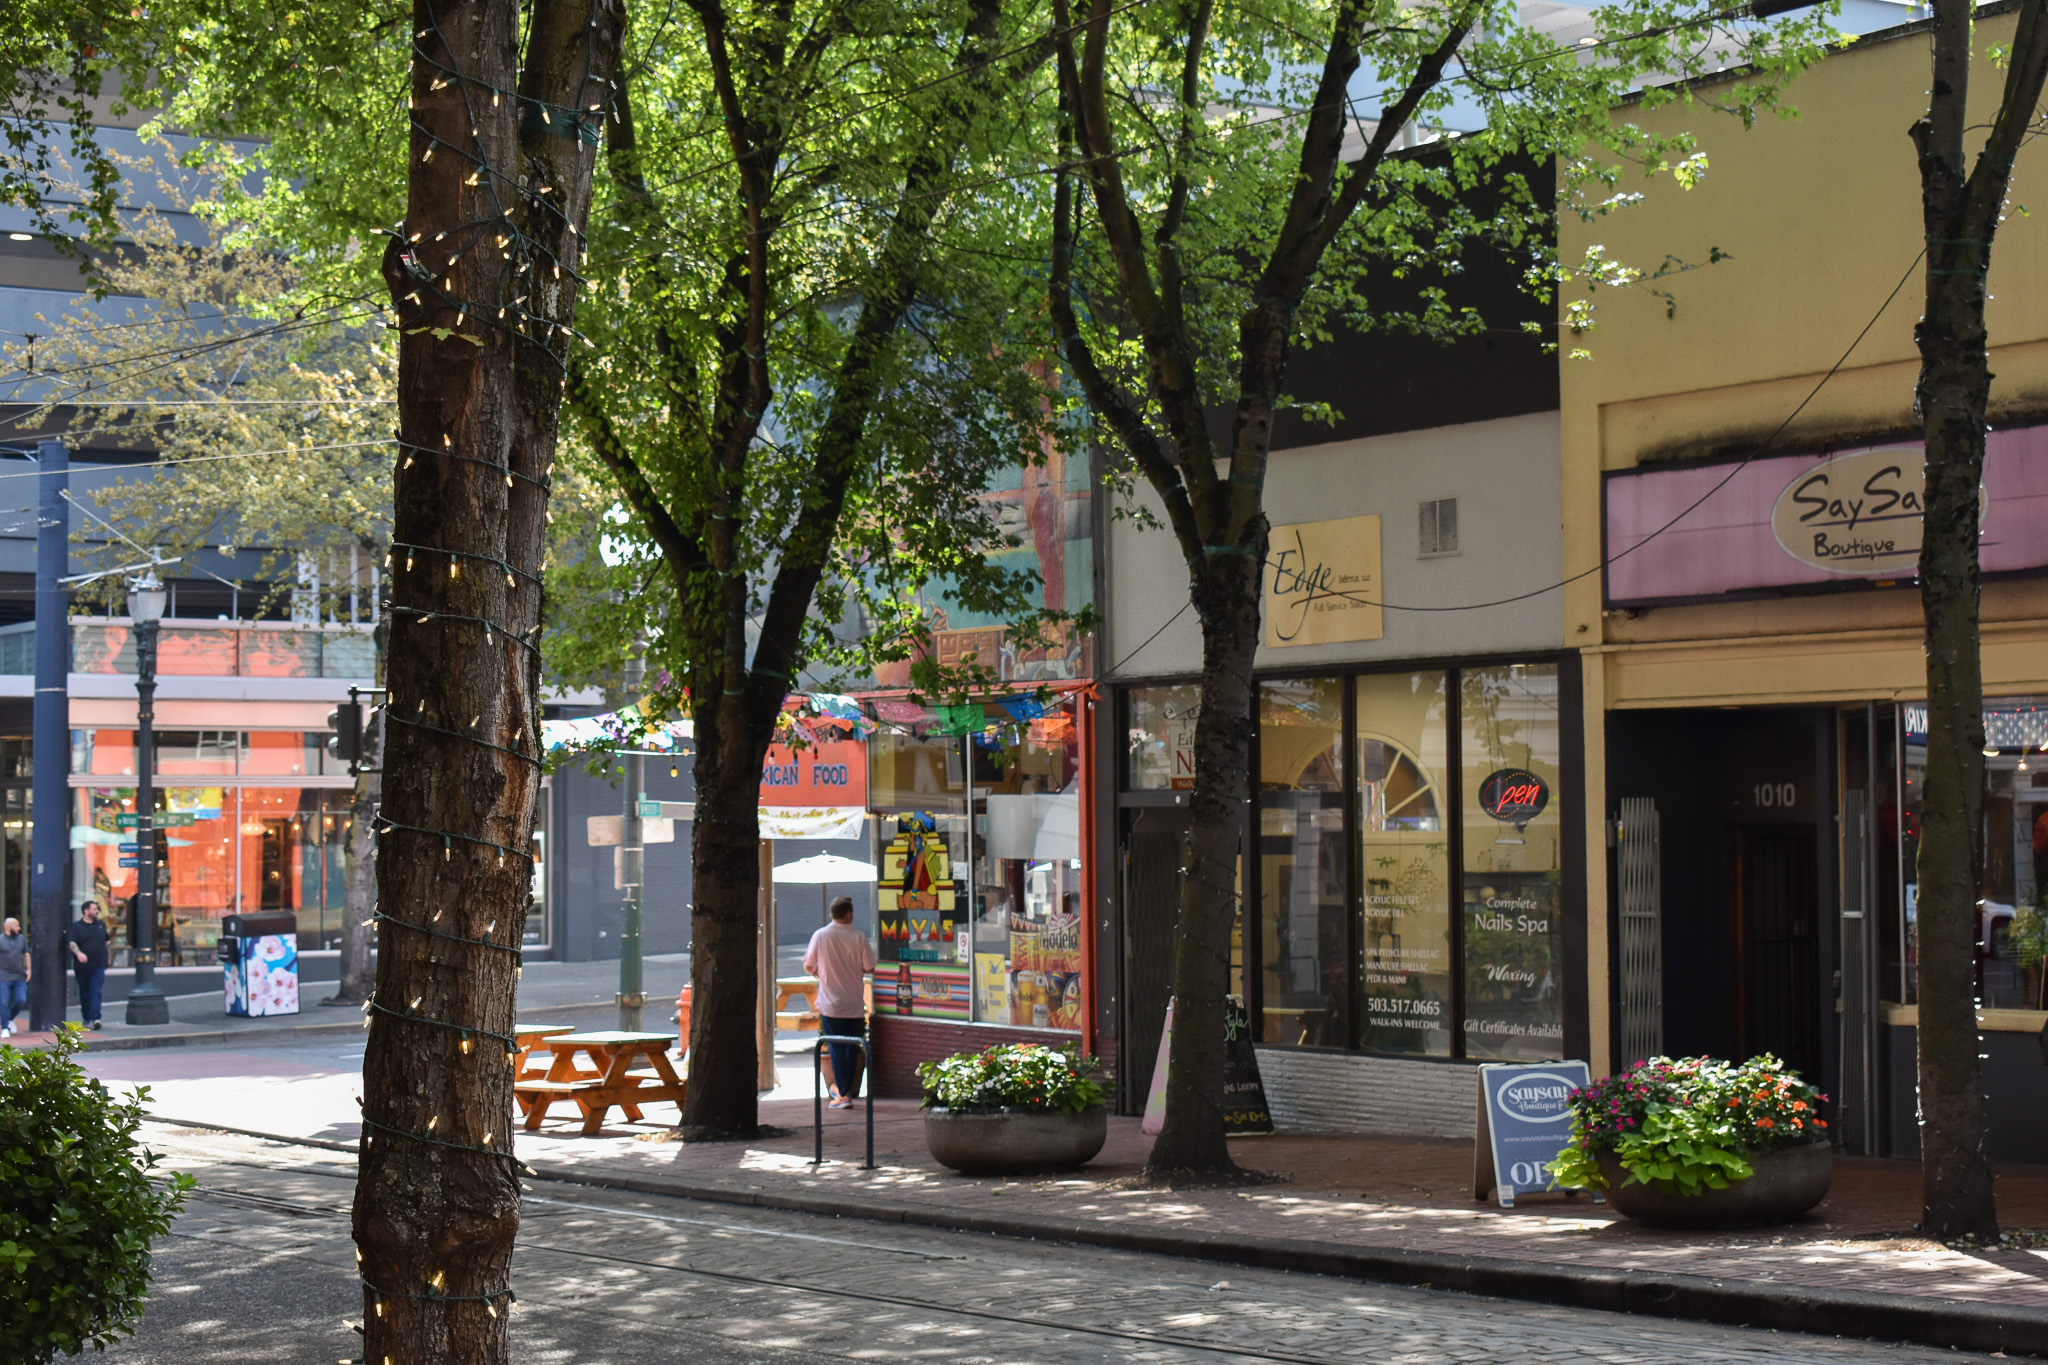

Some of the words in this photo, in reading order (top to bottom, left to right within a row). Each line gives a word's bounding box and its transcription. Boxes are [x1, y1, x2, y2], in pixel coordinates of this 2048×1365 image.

[1793, 466, 1922, 531] SaySa
[1813, 532, 1894, 561] Boutique
[1274, 529, 1335, 640] Edge
[1314, 603, 1325, 612] Full
[1326, 601, 1347, 612] Service
[1177, 729, 1196, 746] Ed
[1176, 750, 1196, 774] N
[759, 764, 799, 786] XICAN
[812, 764, 848, 787] FOOD
[1483, 778, 1540, 813] Open
[1753, 783, 1795, 807] 1010
[1366, 895, 1391, 904] ACRYLIC
[1486, 897, 1537, 911] Complete
[1366, 908, 1391, 917] ACRYLIC
[1392, 908, 1404, 918] FILL
[881, 919, 954, 941] MAYAS
[1474, 914, 1513, 931] Nails
[1517, 915, 1548, 936] Spa
[1366, 949, 1377, 957] SPA
[1410, 949, 1439, 959] SHELLAC
[1366, 974, 1381, 984] PEDI
[1382, 975, 1388, 984] &
[1388, 976, 1407, 985] MANI
[1480, 963, 1536, 988] Waxing
[1367, 997, 1441, 1016] 503.517.0665
[1369, 1017, 1403, 1028] WALK-INS
[1404, 1019, 1440, 1030] WELCOME
[1463, 1018, 1478, 1033] Gift
[1480, 1020, 1525, 1036] Certificates
[1508, 1086, 1568, 1104] saysay
[1523, 1101, 1558, 1112] boutique
[1504, 1134, 1570, 1143] www.saysayboutique
[1510, 1161, 1547, 1186] OP
